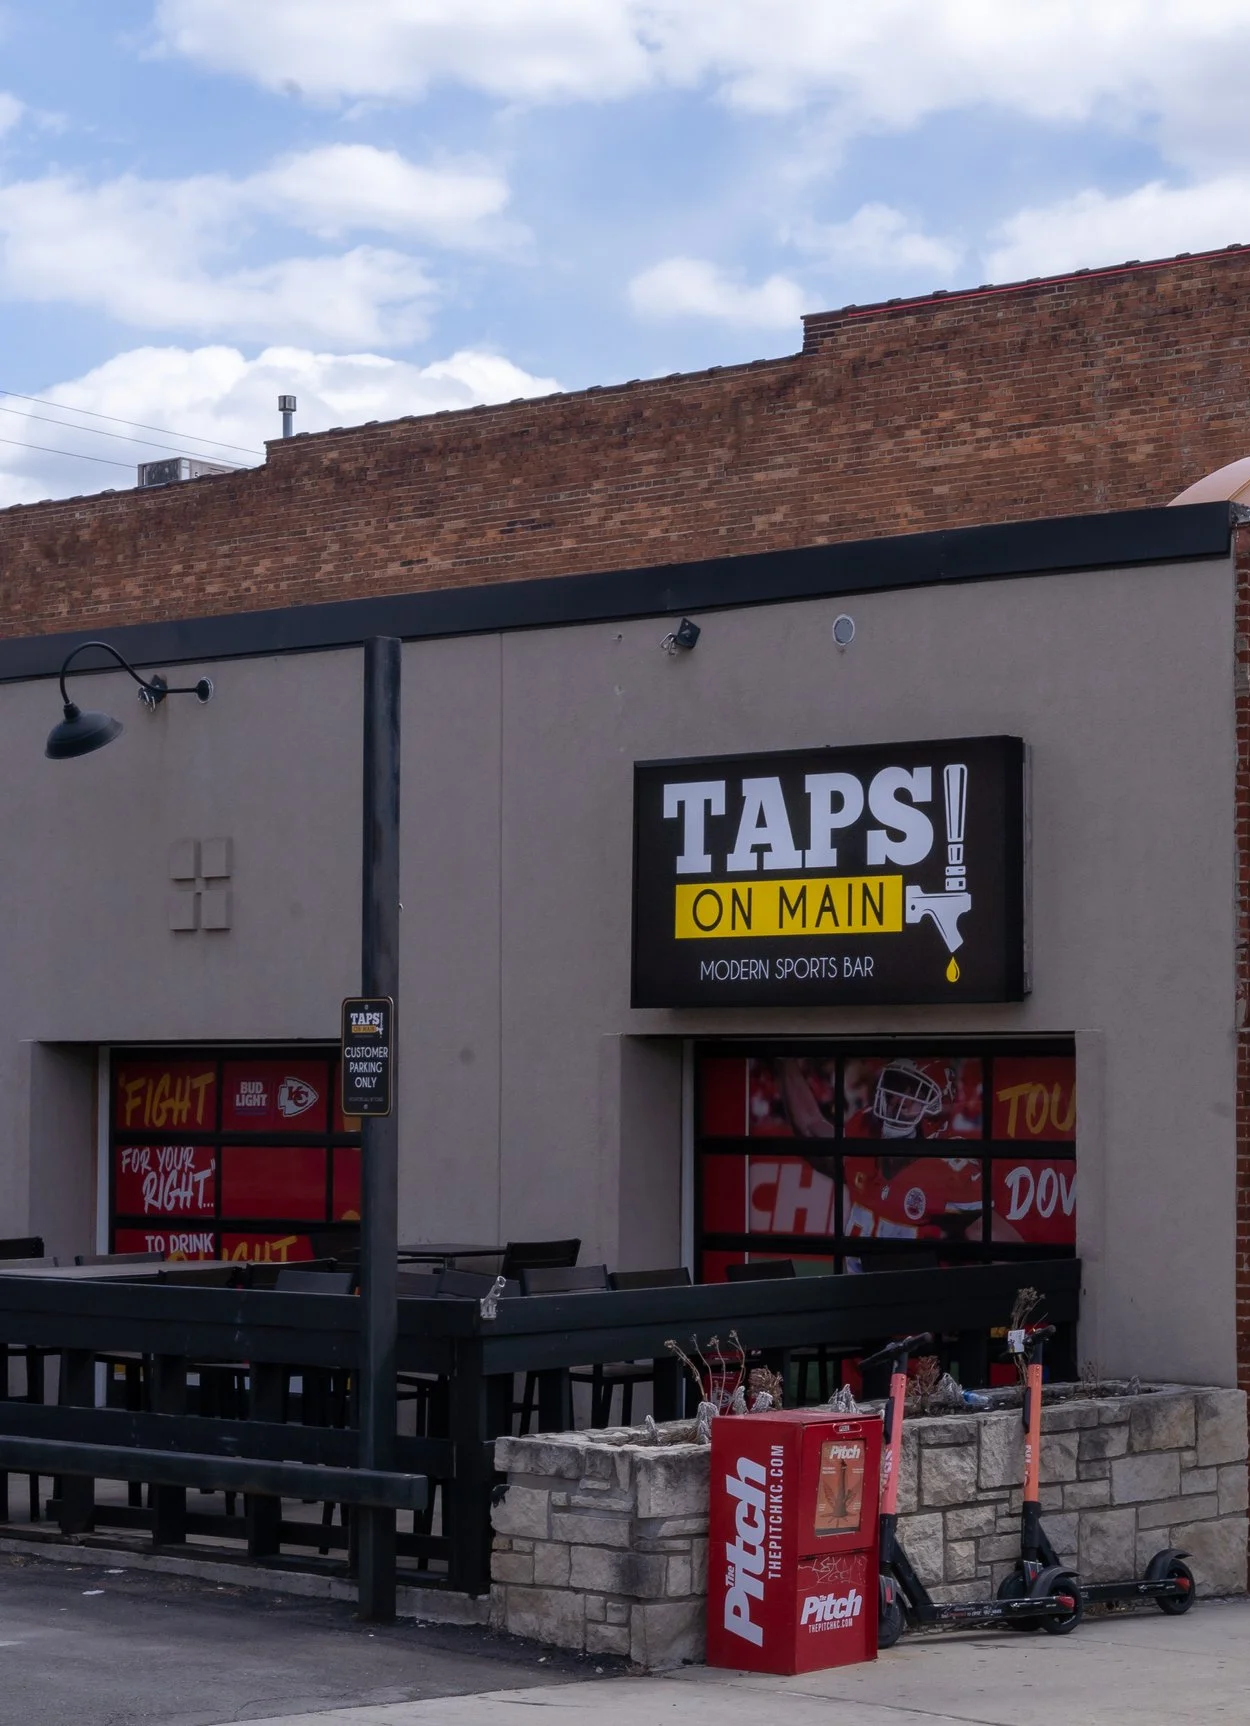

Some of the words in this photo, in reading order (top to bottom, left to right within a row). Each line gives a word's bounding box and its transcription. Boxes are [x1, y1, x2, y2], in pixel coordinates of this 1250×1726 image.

[692, 886, 753, 932] ON
[779, 881, 884, 930] MAIN
[700, 957, 769, 981] MODERN
[775, 956, 838, 980] SPORTS
[843, 955, 874, 978] BAR
[344, 1046, 389, 1058] CUSTOMER
[349, 1061, 383, 1073] PARKING
[240, 1081, 264, 1094] BUD
[354, 1076, 378, 1088] ONLY
[235, 1093, 268, 1107] LIGHT
[121, 1147, 152, 1175] FOR
[156, 1146, 195, 1173] YOUR
[144, 1234, 165, 1253] TO
[169, 1232, 214, 1254] DRINK
[829, 1445, 861, 1460] Pitch
[768, 1444, 784, 1580] THEPITCHKC.COM
[724, 1456, 767, 1648] Pitch
[725, 1565, 736, 1587] The
[800, 1588, 863, 1625] Pitch
[808, 1618, 853, 1634] THEPITCHKC.COM
